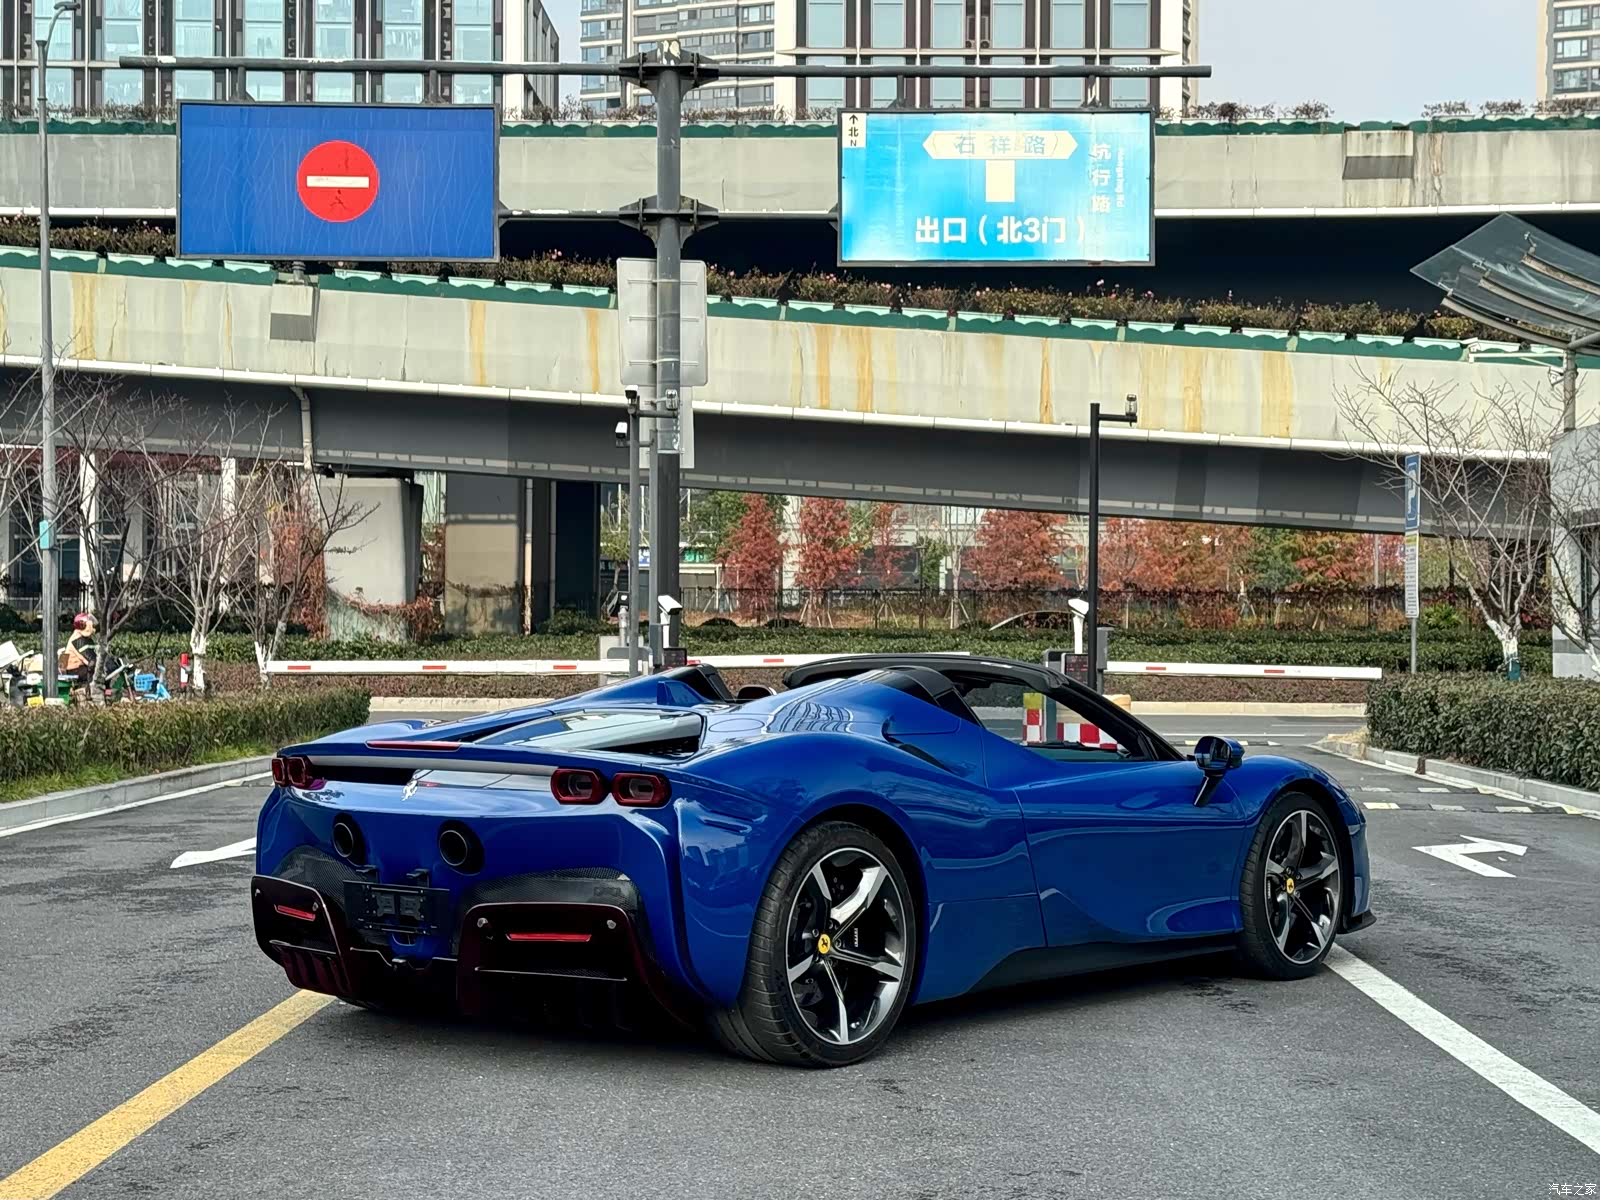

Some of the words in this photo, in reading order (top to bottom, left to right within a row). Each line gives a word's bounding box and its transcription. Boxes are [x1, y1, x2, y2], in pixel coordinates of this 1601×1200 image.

[848, 127, 859, 138] 北
[850, 139, 857, 147] N
[953, 135, 1046, 155] 石祥路
